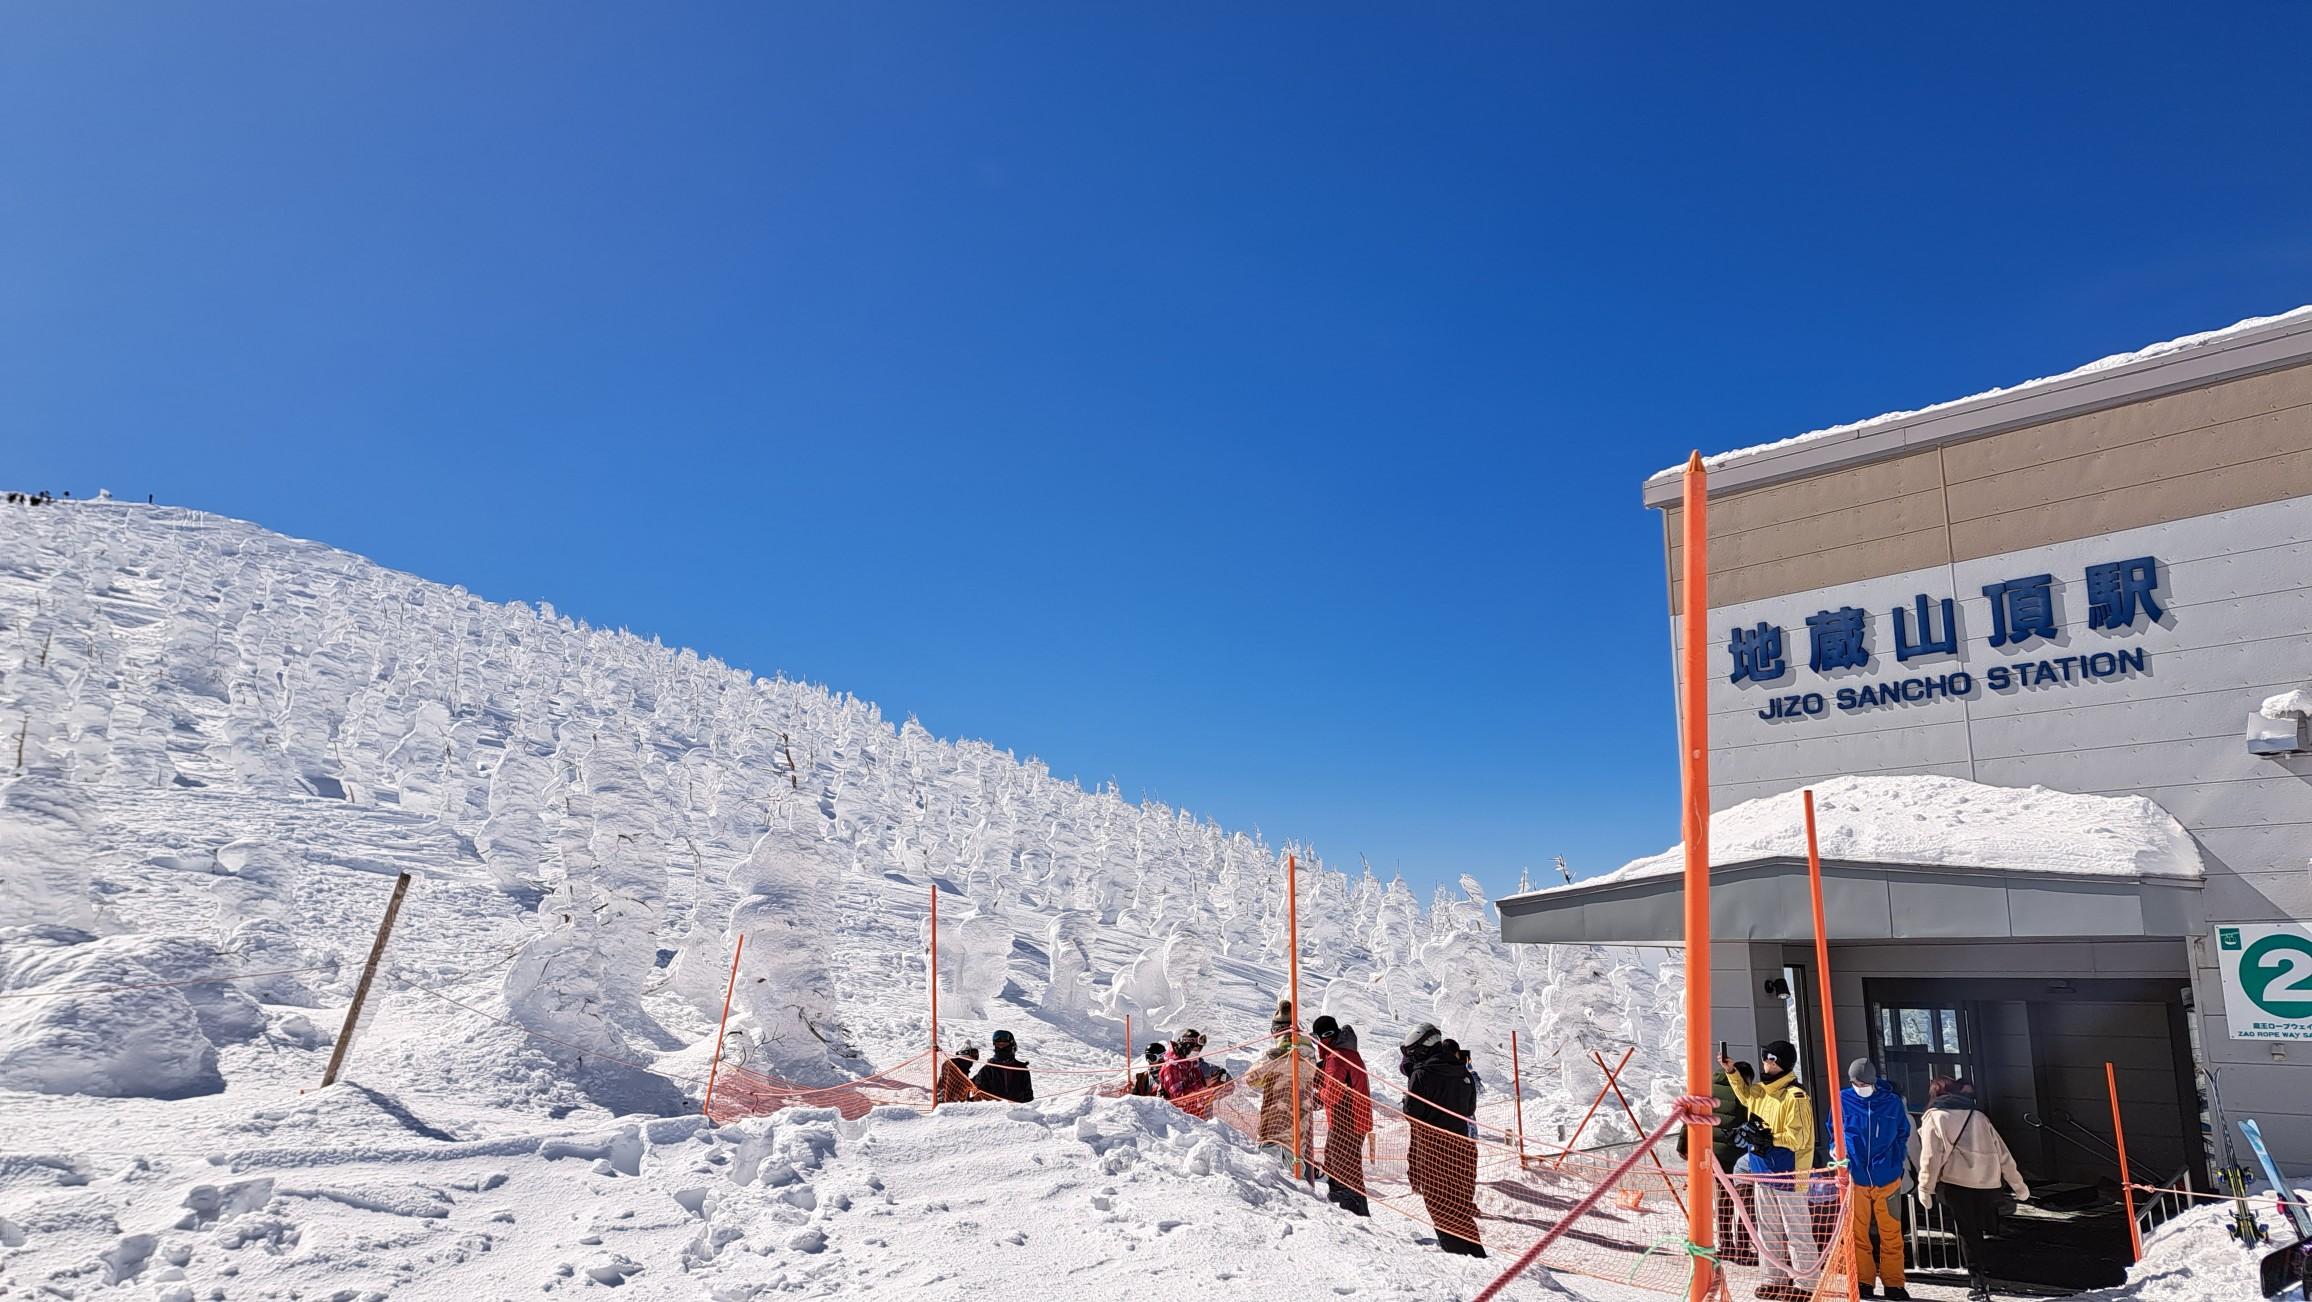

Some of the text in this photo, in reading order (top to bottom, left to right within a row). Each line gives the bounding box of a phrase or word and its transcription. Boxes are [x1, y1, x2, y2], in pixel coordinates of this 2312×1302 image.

[1728, 556, 2163, 684] 地蔵山頂駅
[1758, 647, 2145, 720] JIZO SANCHO STATION
[2258, 948, 2312, 1002] 2
